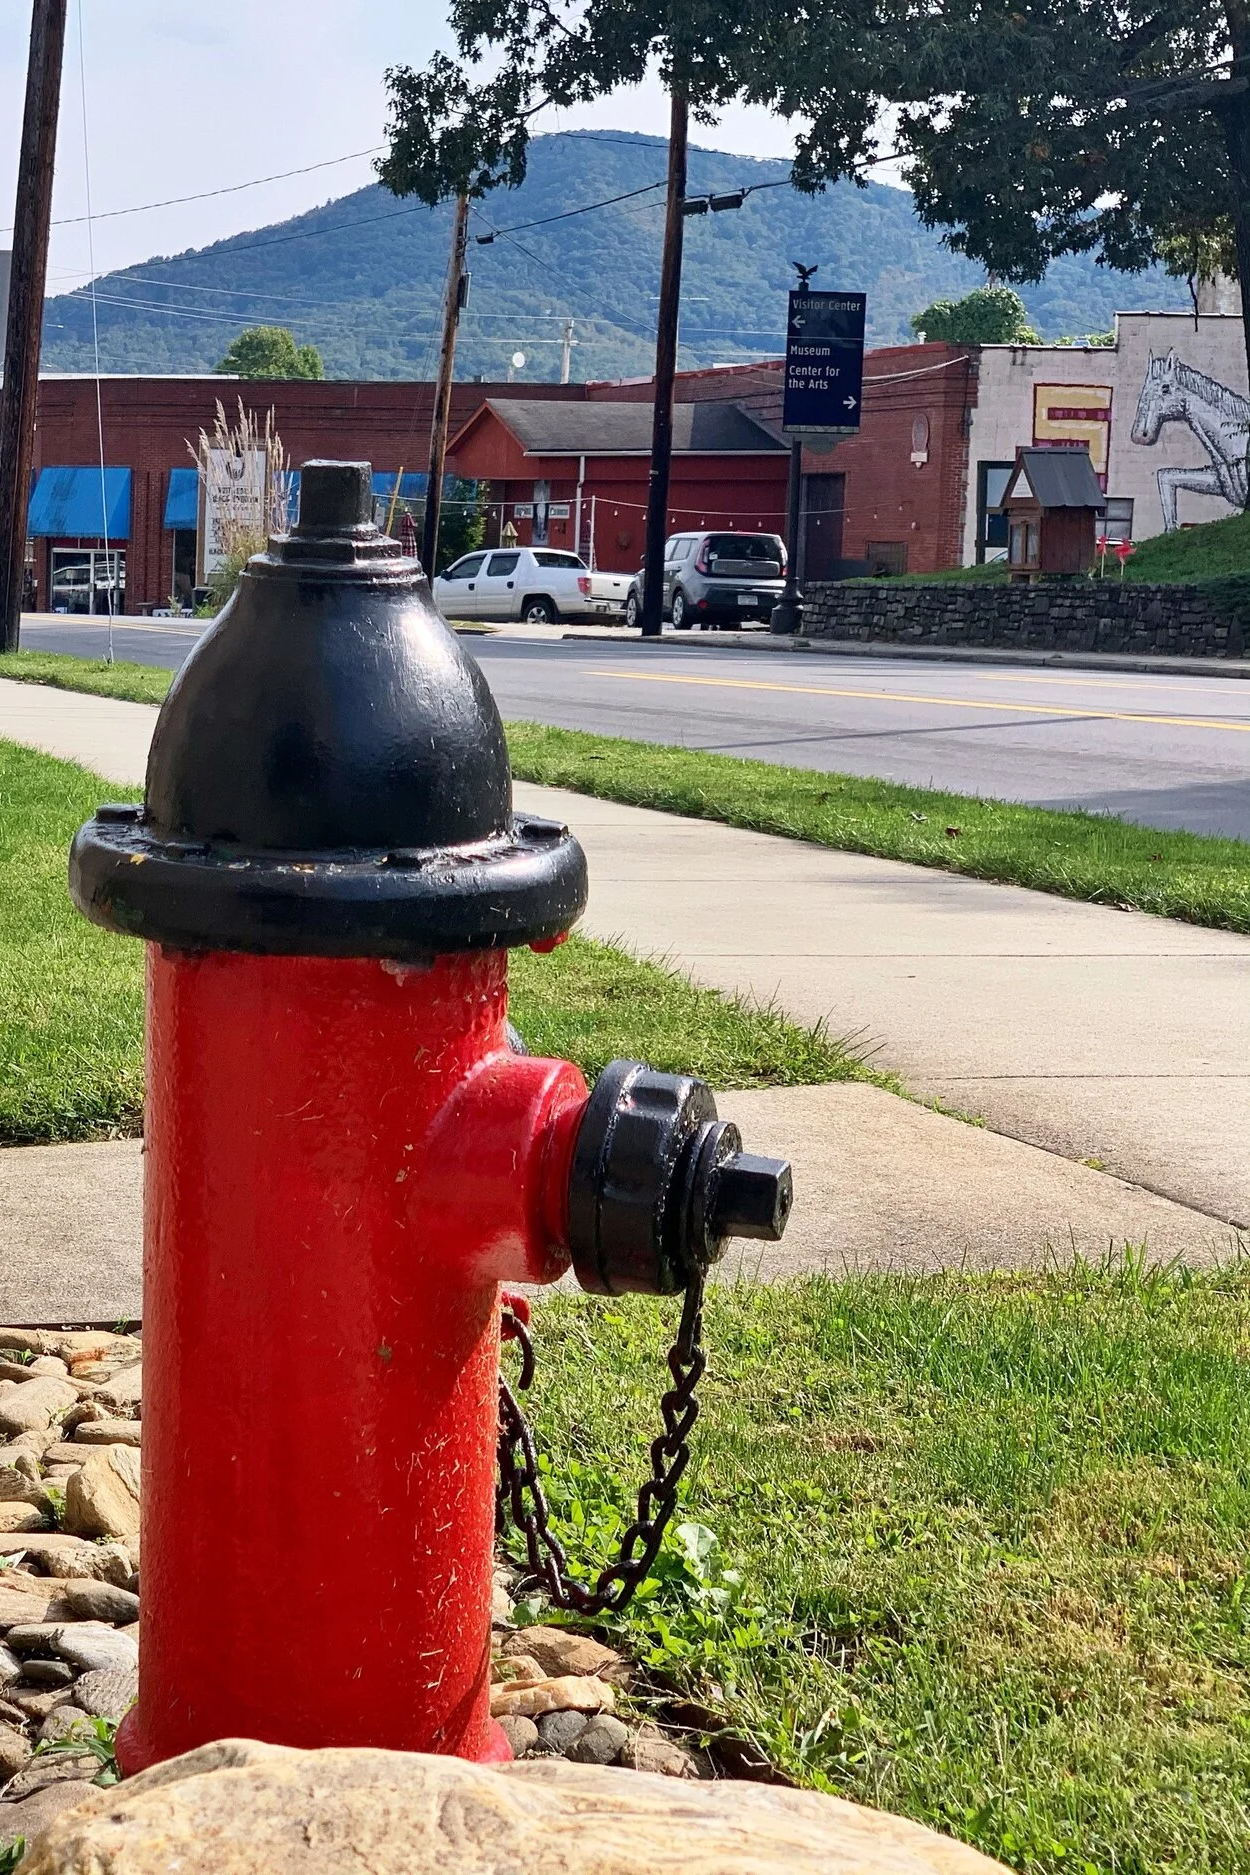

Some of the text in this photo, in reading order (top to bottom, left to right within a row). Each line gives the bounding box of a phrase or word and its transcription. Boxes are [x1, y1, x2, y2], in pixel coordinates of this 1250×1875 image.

[792, 299, 861, 311] Visitor Center
[790, 345, 831, 356] Museum
[789, 366, 841, 377] Center for
[788, 378, 829, 390] the Arts
